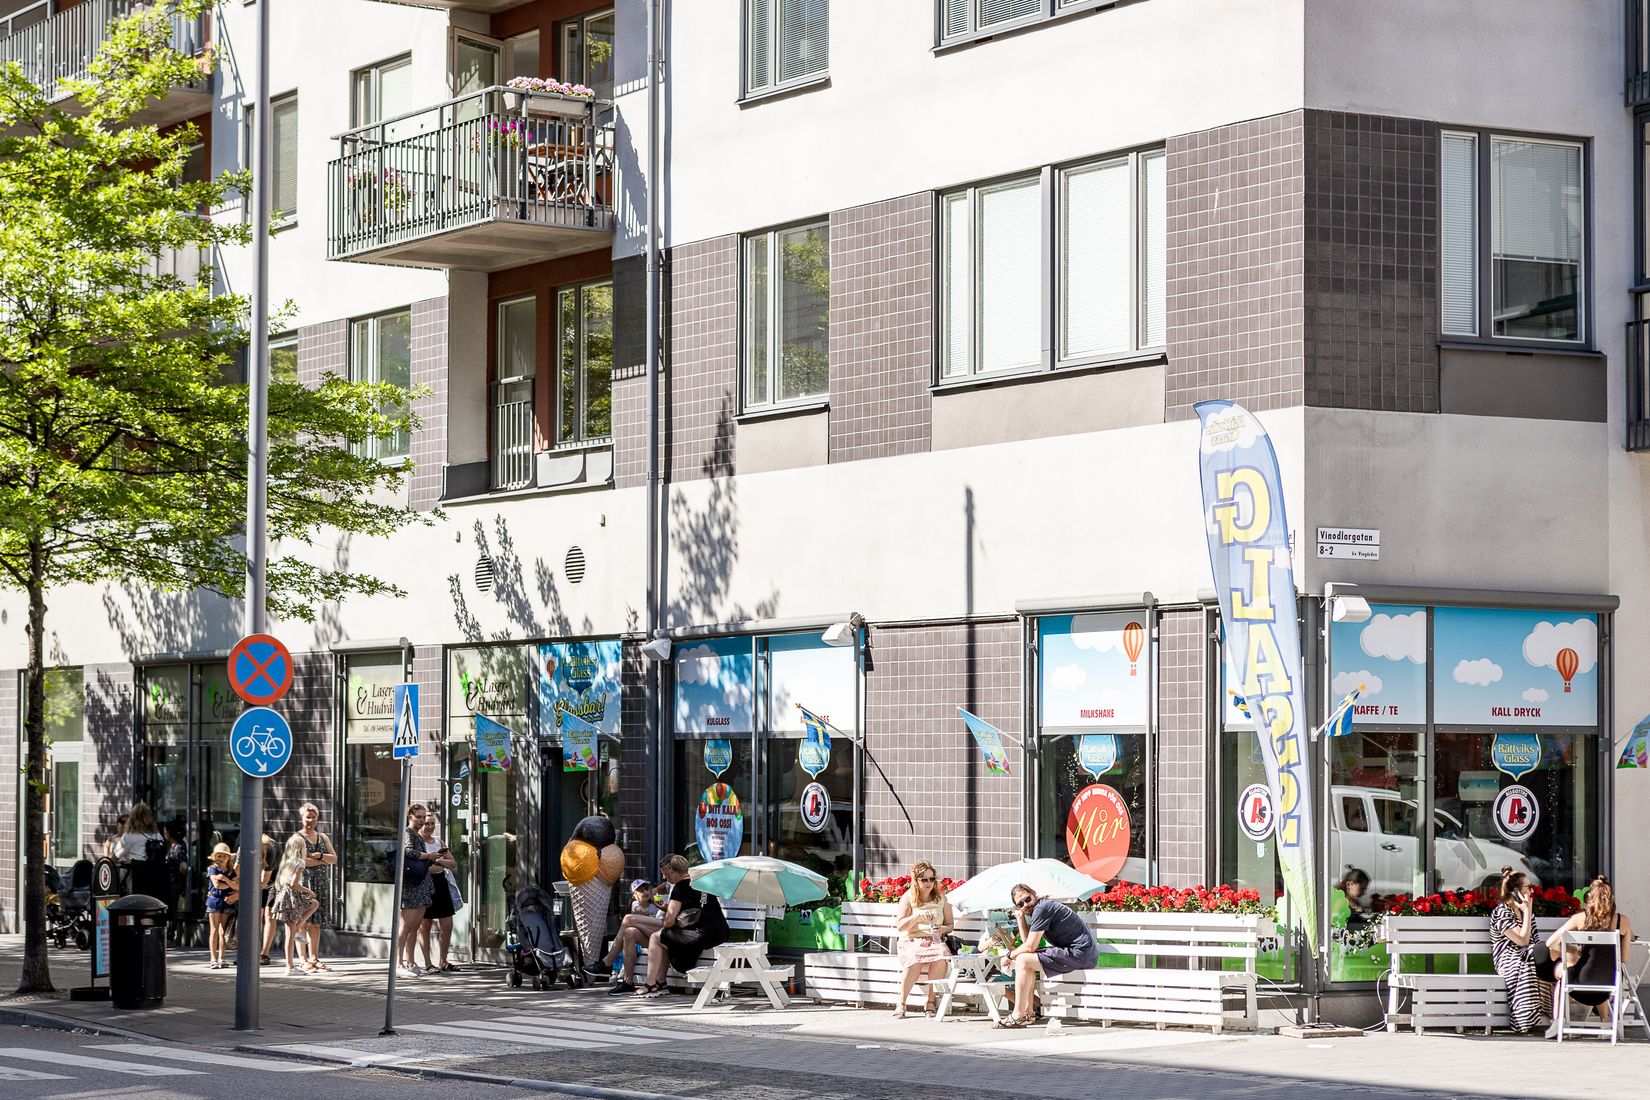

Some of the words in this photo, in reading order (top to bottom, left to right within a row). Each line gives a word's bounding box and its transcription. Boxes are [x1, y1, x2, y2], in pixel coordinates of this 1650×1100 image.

[1320, 530, 1373, 543] Vinodlargatan
[1319, 545, 1334, 555] 8-2
[372, 683, 395, 698] Laser-
[1080, 708, 1115, 719] MILKSHAKE
[1354, 705, 1379, 715] KAFFE
[1388, 705, 1399, 716] TE
[1491, 706, 1512, 717] KALL
[1513, 707, 1541, 718] DRYCK
[706, 717, 730, 726] KULGLASS
[1498, 743, 1535, 754] Rättviks
[1503, 754, 1530, 763] Glass
[708, 804, 721, 815] DITT
[706, 817, 718, 828] HOS
[719, 818, 732, 829] OSS!
